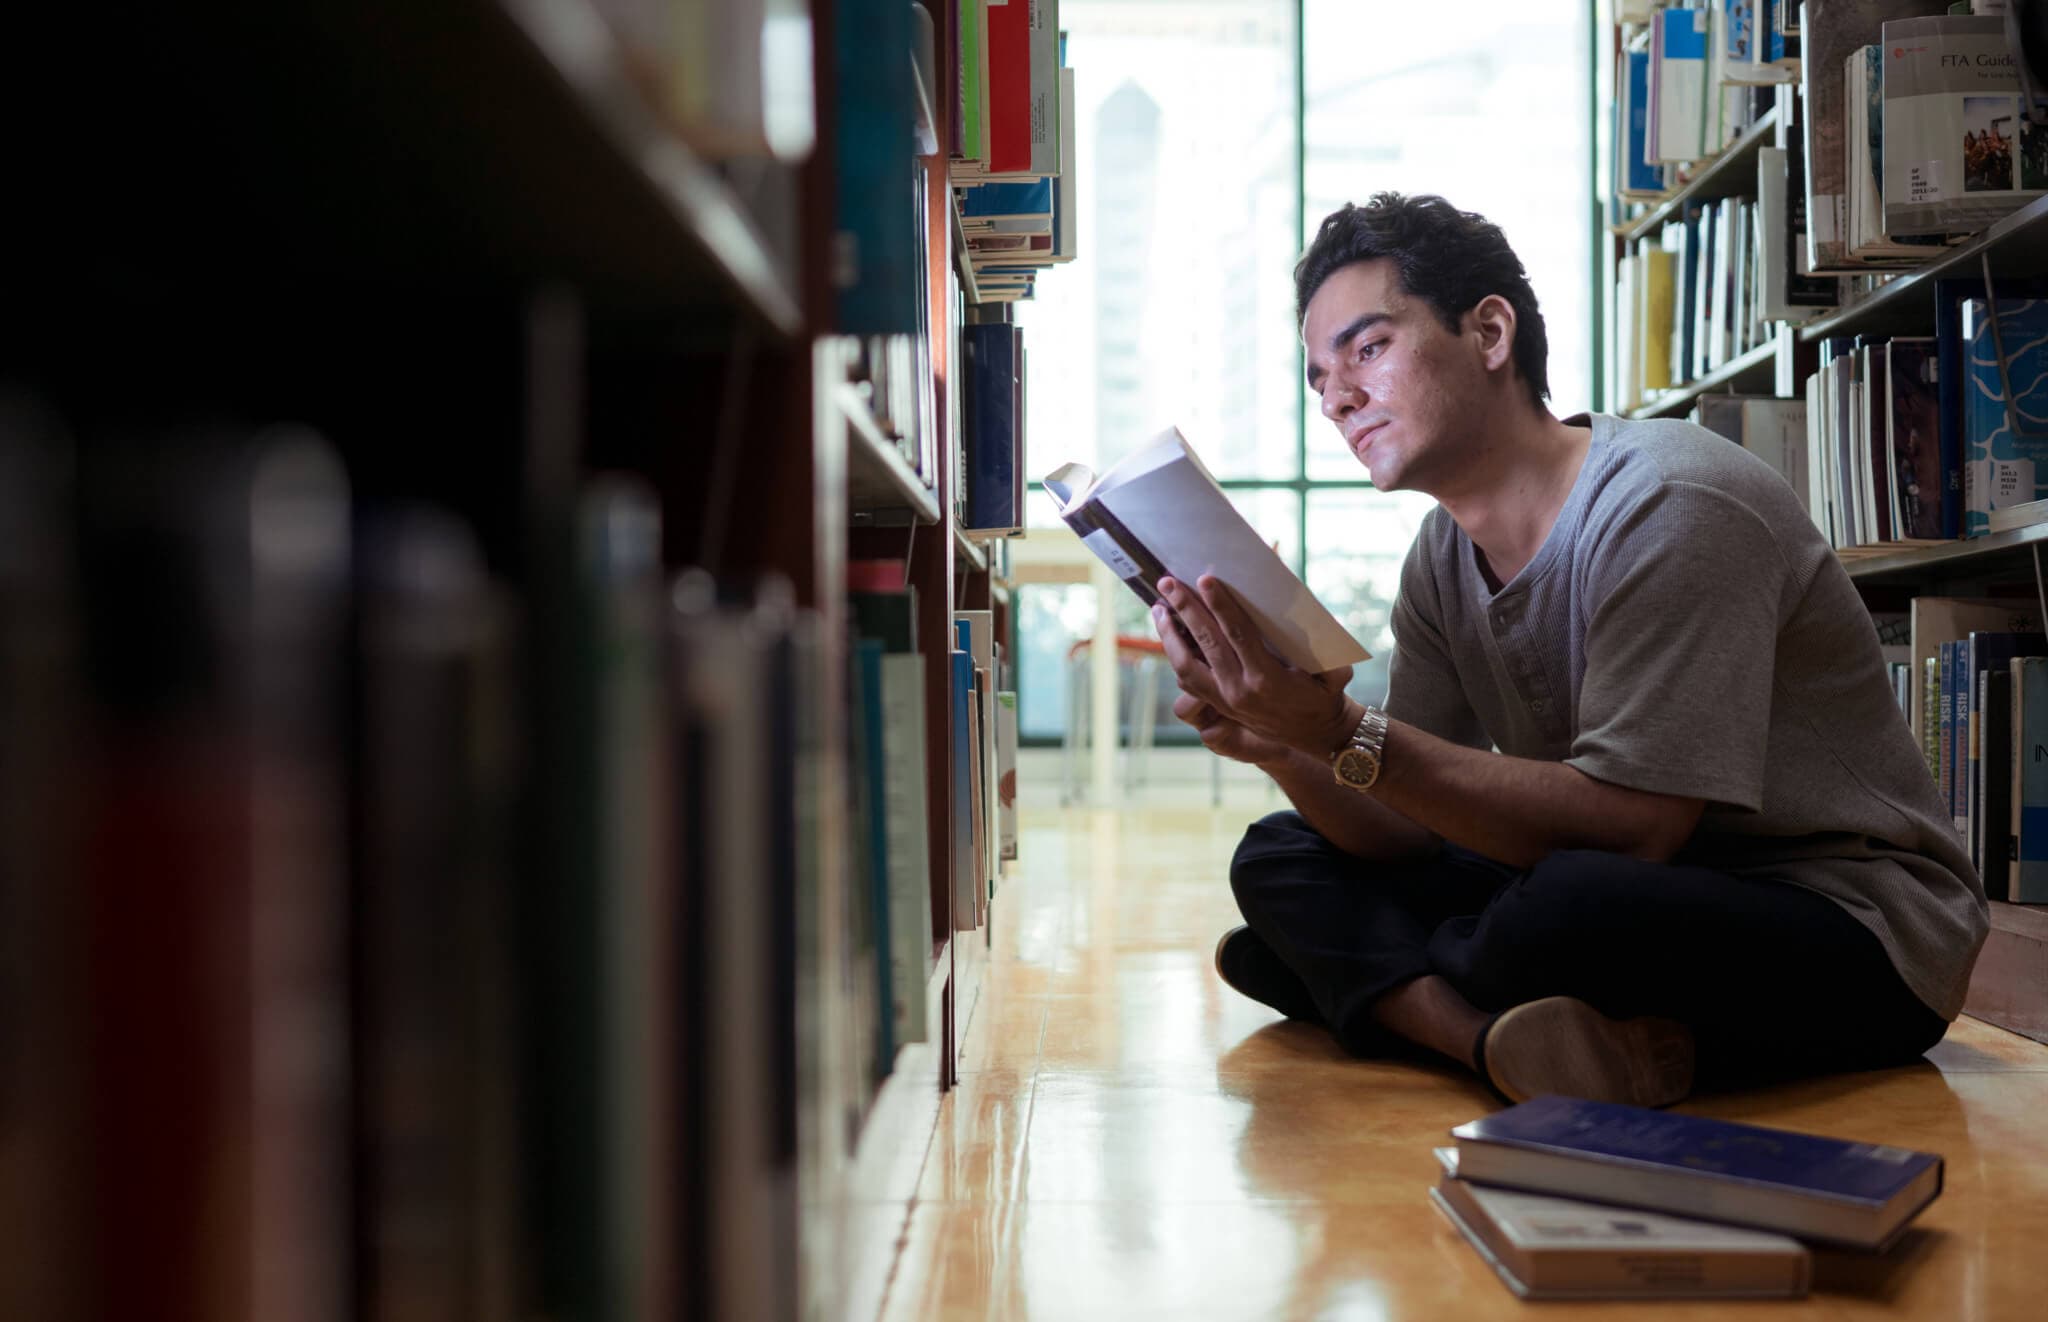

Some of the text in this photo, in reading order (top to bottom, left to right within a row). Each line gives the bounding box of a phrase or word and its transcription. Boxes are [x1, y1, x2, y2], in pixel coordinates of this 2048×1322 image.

[1941, 55, 1970, 67] FTA
[1941, 694, 1951, 723] RISK
[1956, 692, 1967, 721] RISK
